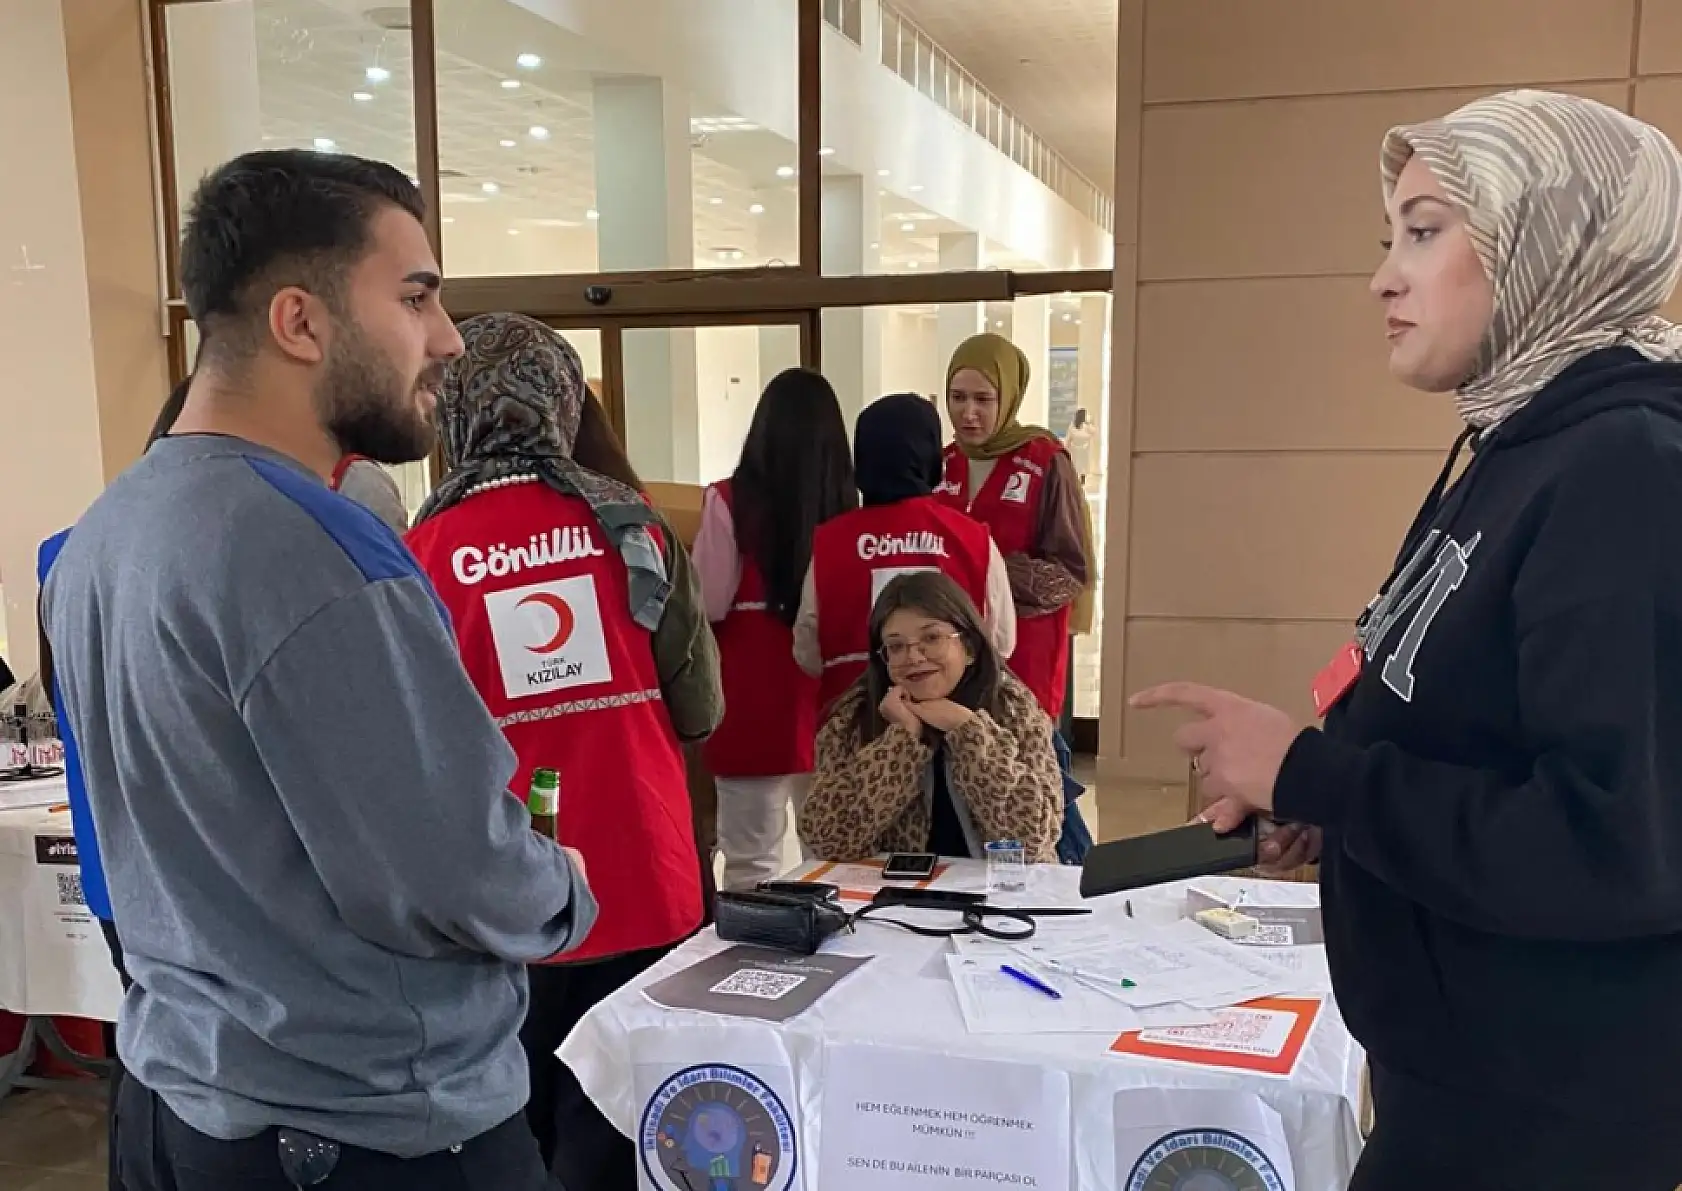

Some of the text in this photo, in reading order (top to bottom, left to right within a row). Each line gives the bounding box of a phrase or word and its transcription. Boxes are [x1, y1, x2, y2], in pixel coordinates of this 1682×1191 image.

[452, 526, 604, 584] Gönüllü
[857, 531, 950, 560] Gönüllü
[527, 662, 583, 685] KIZILAY
[856, 1102, 881, 1112] HEM
[943, 1110, 968, 1121] HEM
[912, 1123, 963, 1138] MÜMKÜN
[847, 1156, 871, 1168] SEN
[872, 1160, 887, 1170] DE
[889, 1161, 905, 1171] BU
